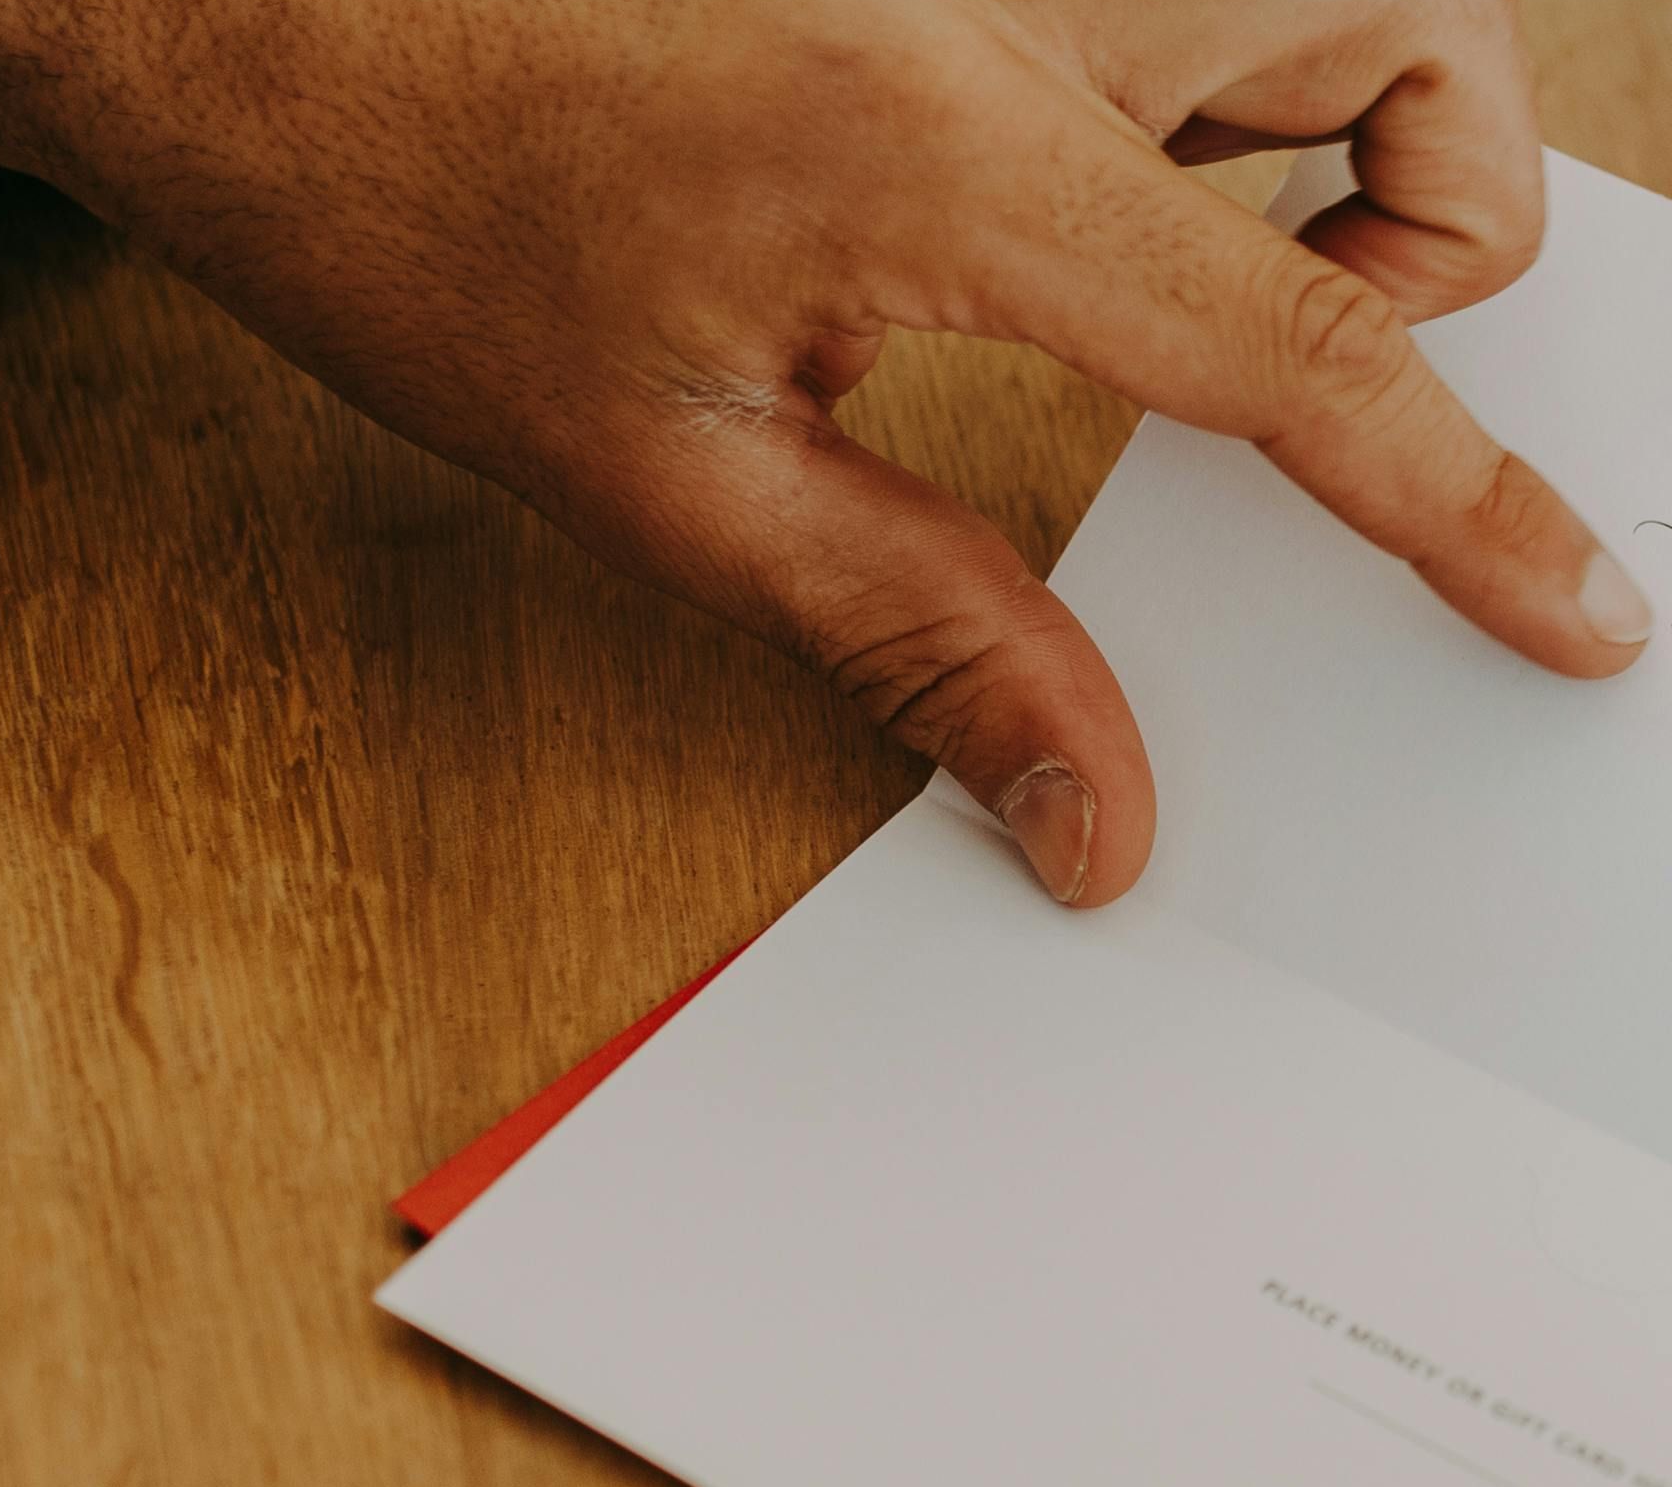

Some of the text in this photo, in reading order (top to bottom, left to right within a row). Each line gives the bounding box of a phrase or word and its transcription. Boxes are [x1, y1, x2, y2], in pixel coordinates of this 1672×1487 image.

[1261, 1278, 1337, 1329] PLACE
[1345, 1323, 1440, 1381] MONEY
[1445, 1377, 1483, 1404] OR
[1491, 1400, 1549, 1436] GIFT
[1554, 1433, 1627, 1478] CARD
